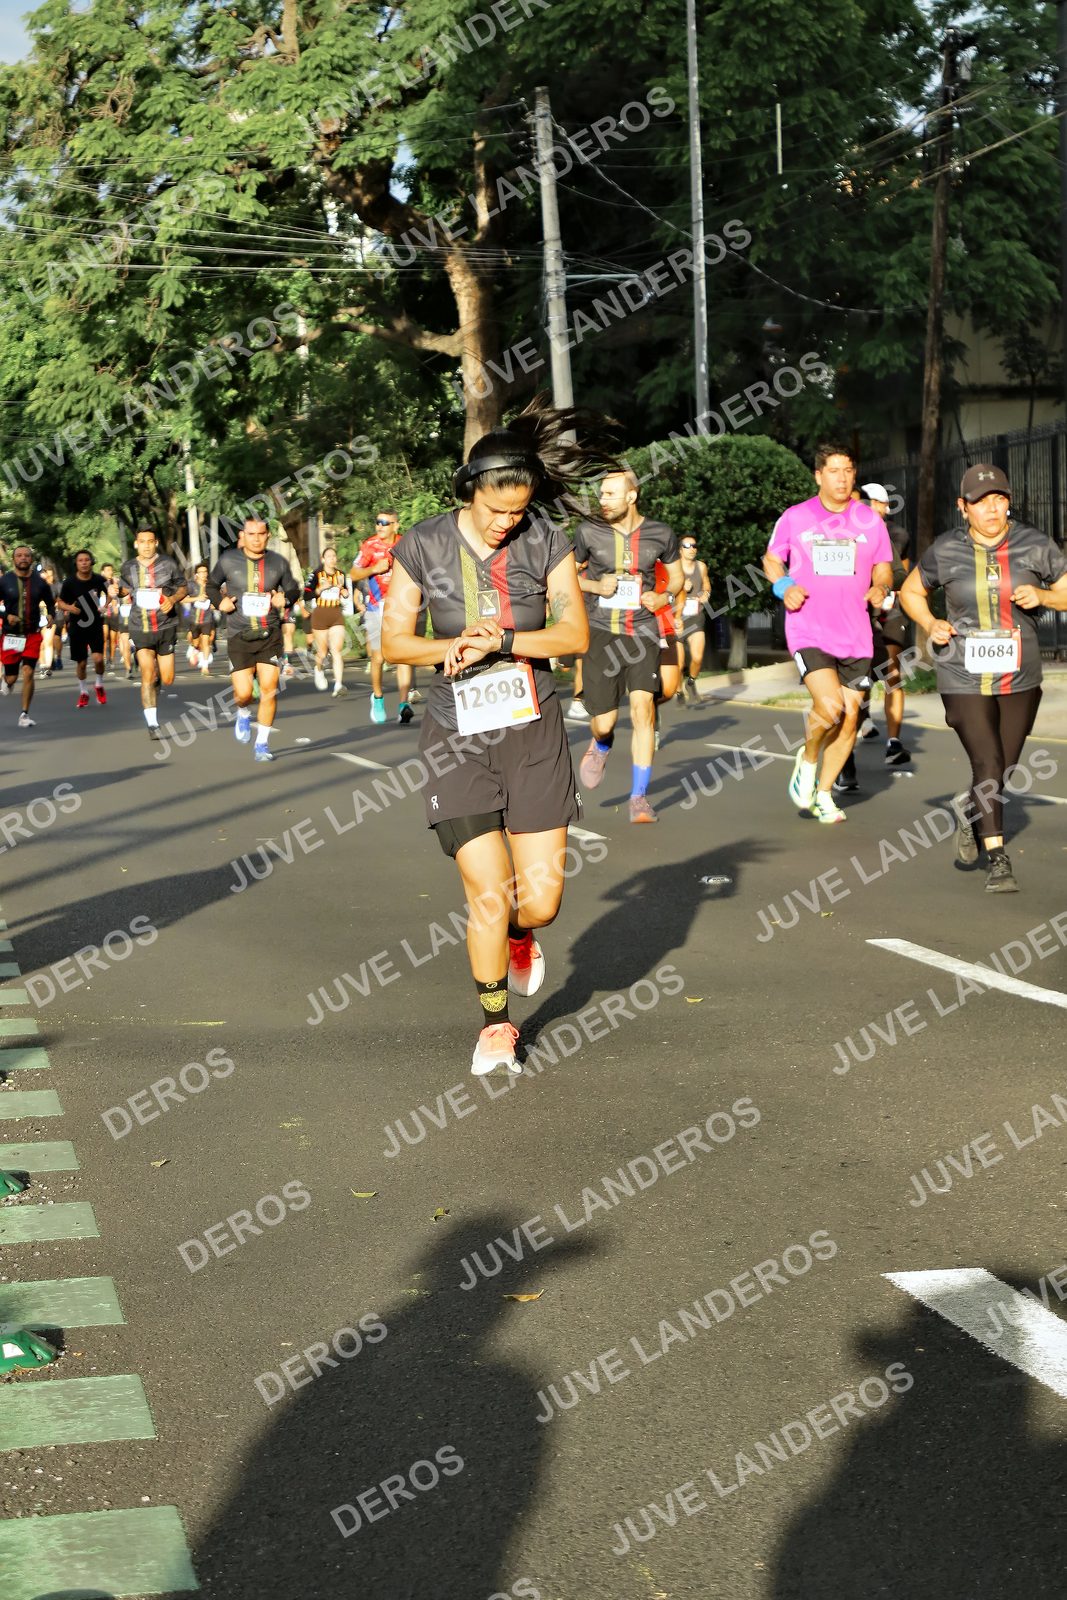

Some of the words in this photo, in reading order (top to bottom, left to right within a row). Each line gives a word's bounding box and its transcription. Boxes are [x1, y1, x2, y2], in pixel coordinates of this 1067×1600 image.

[817, 551, 851, 562] 13395
[970, 644, 1014, 658] 10684
[457, 676, 526, 711] 12698
